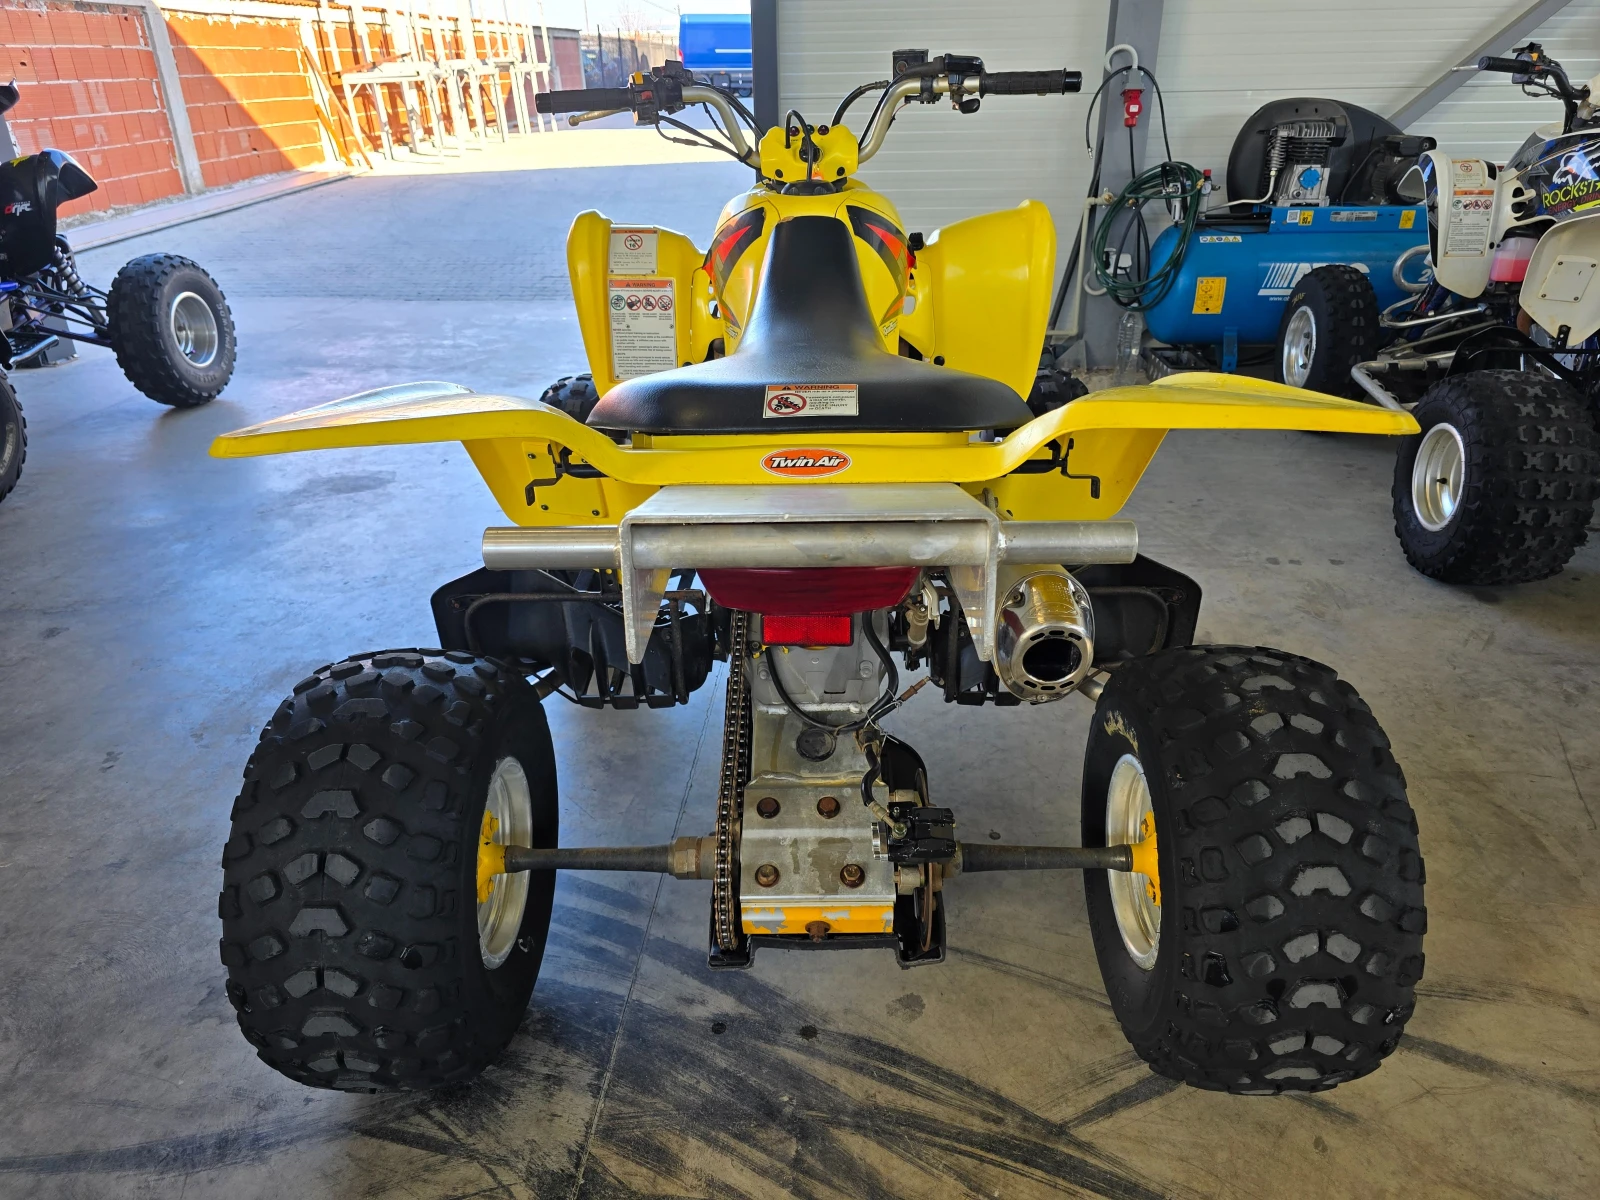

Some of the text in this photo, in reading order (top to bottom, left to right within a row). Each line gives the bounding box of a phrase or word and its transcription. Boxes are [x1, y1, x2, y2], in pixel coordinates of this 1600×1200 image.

[1548, 199, 1577, 215] ENERGY
[771, 456, 845, 468] Twin Air
